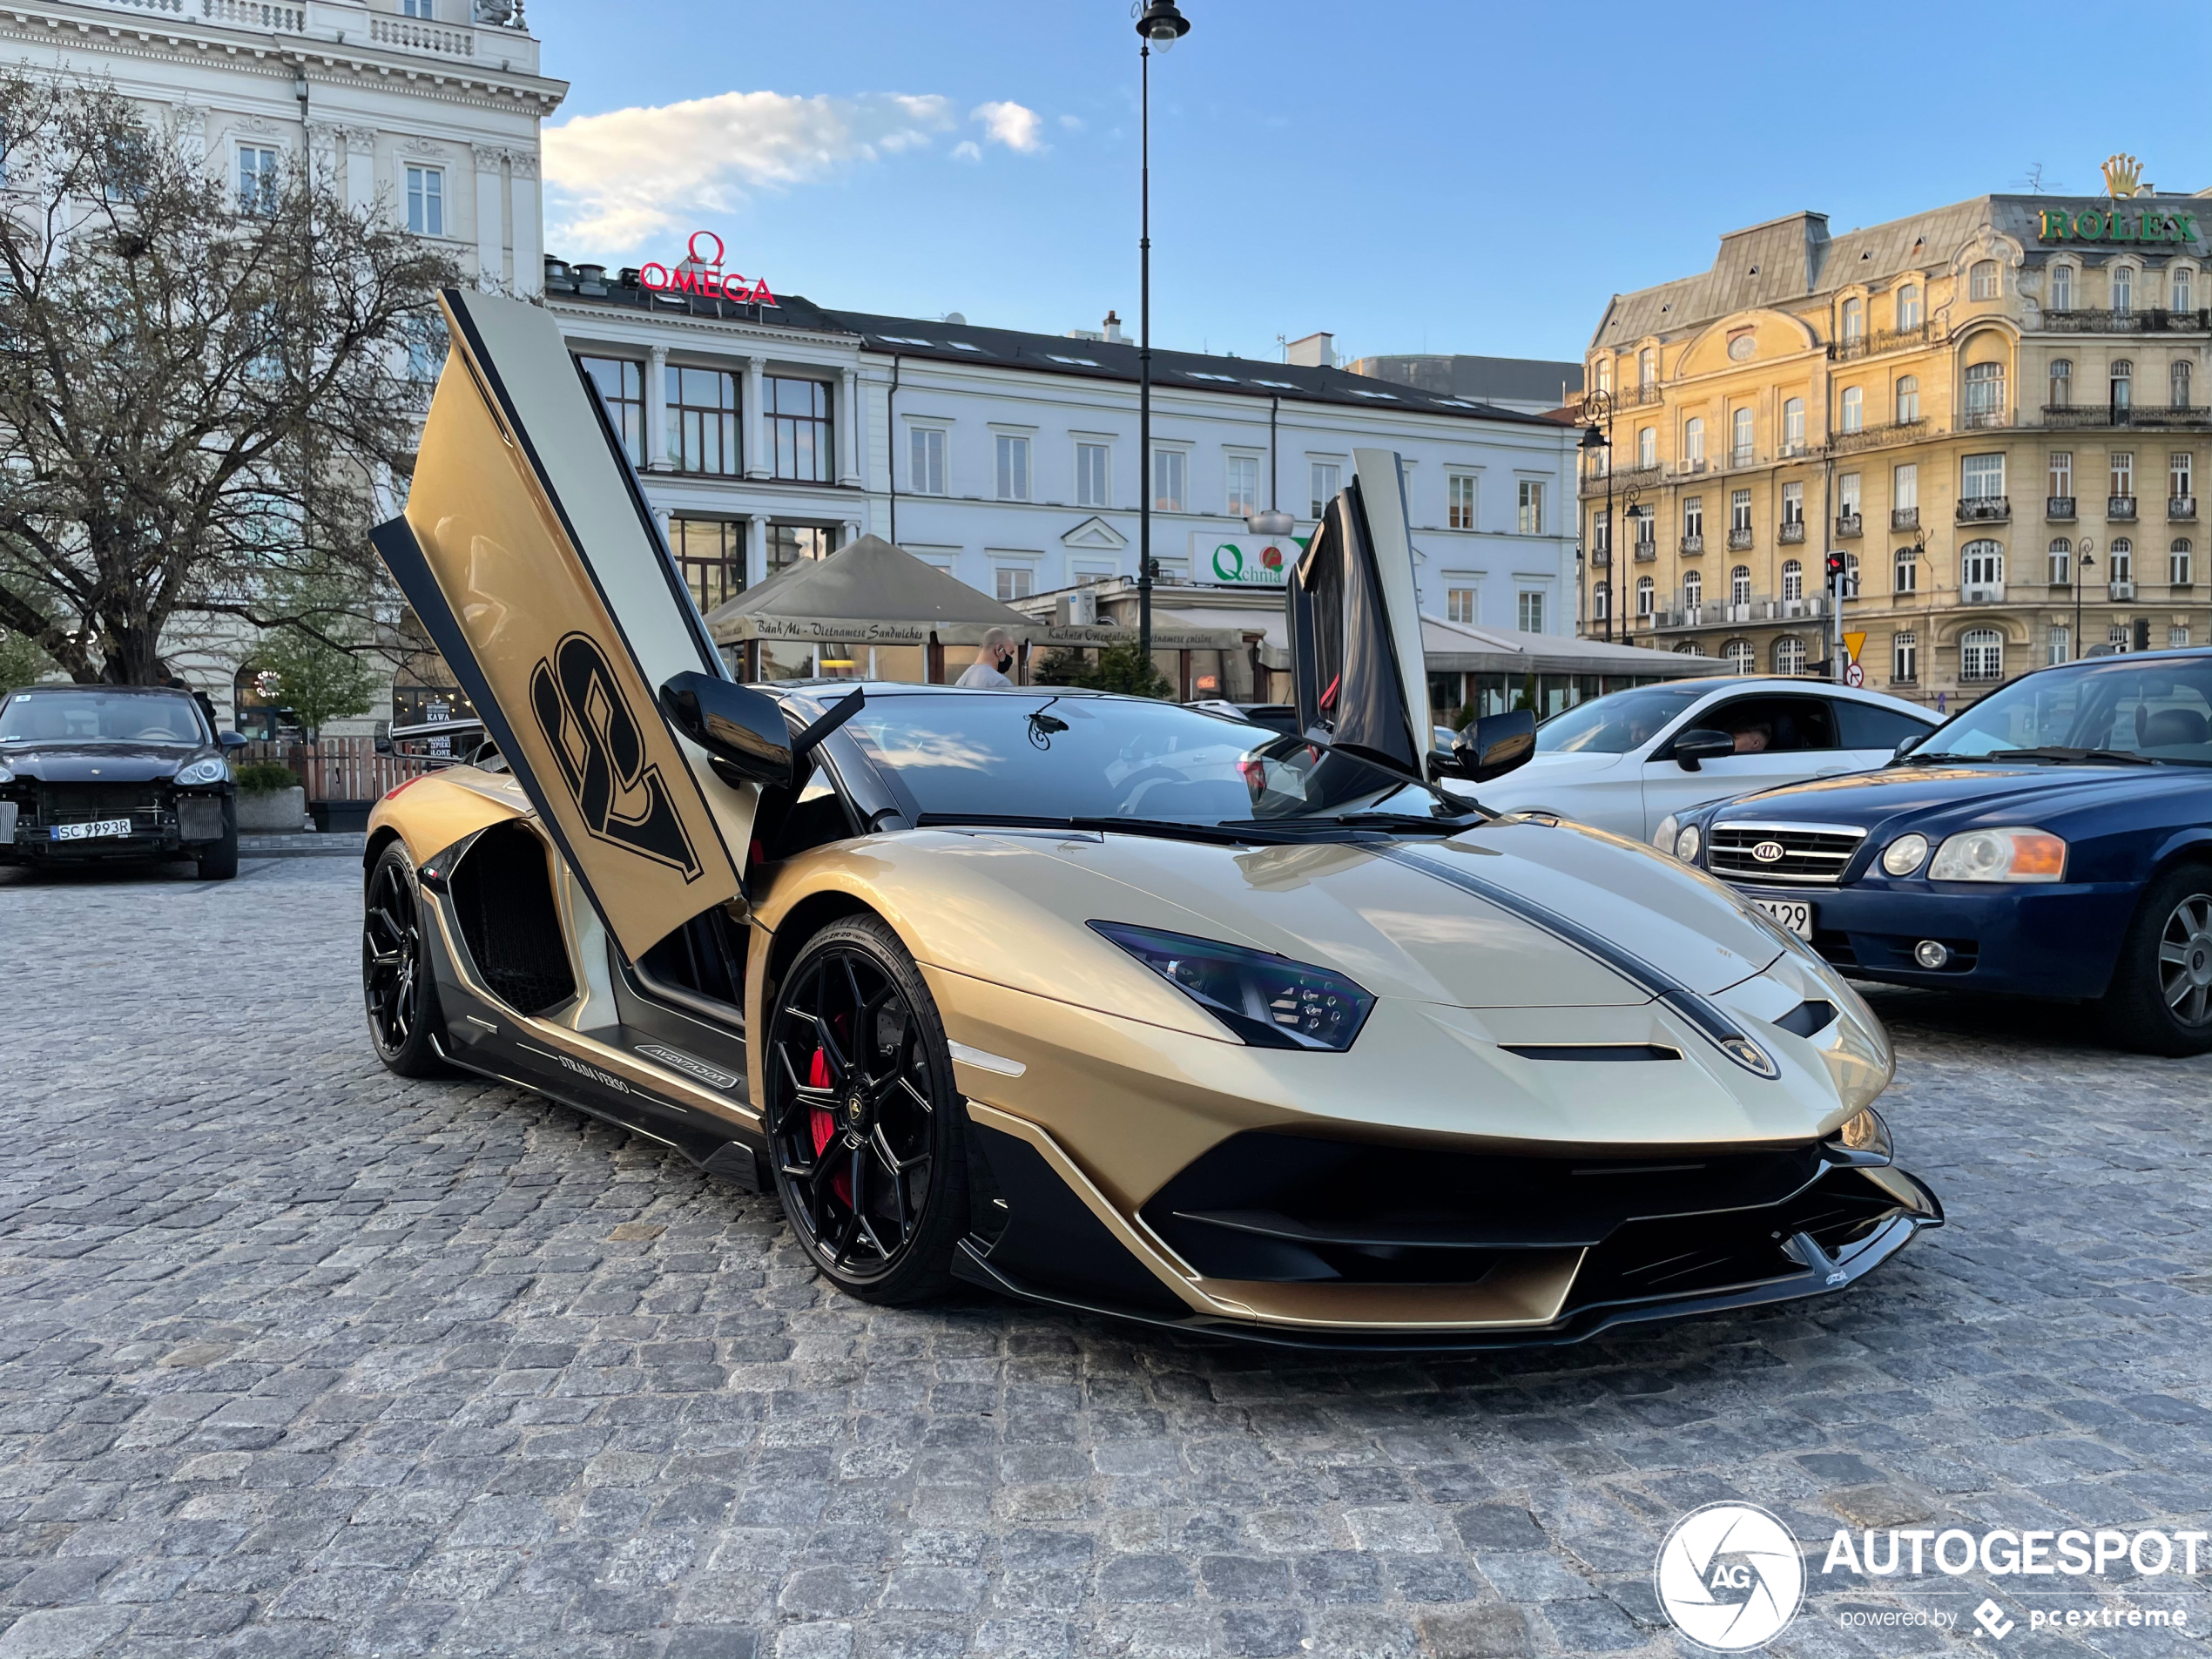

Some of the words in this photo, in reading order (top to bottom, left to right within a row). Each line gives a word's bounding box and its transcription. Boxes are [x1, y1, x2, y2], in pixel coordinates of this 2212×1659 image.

[2039, 209, 2198, 241] ROLEX
[640, 262, 777, 306] OMEGA
[1212, 543, 1282, 583] Qchnia
[755, 620, 782, 634] Bánh
[811, 623, 866, 638] Vietnamese
[867, 624, 923, 639] Sandwiches
[1048, 629, 1082, 641] Kuchnia
[60, 826, 80, 838] SC
[85, 821, 128, 837] 9993R
[1757, 846, 1778, 858] KIA
[558, 1055, 597, 1081] STRADA
[594, 1069, 629, 1094] VERSO
[651, 1049, 727, 1082] AVENTADOR
